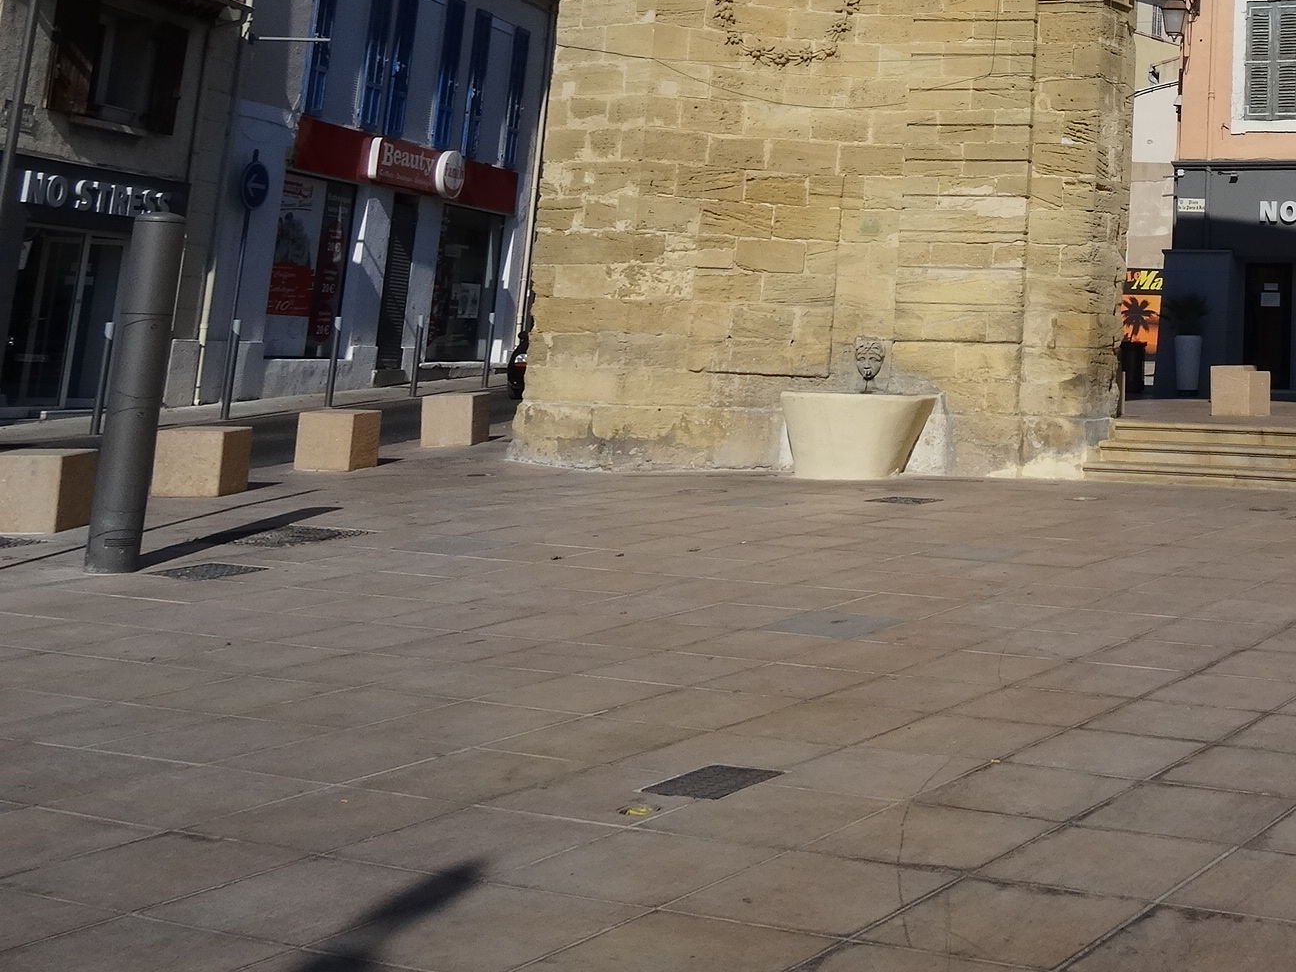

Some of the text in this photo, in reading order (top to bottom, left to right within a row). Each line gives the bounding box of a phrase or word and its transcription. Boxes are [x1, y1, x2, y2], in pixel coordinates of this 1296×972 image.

[382, 142, 436, 176] Beauty
[20, 170, 172, 217] NO STRESS
